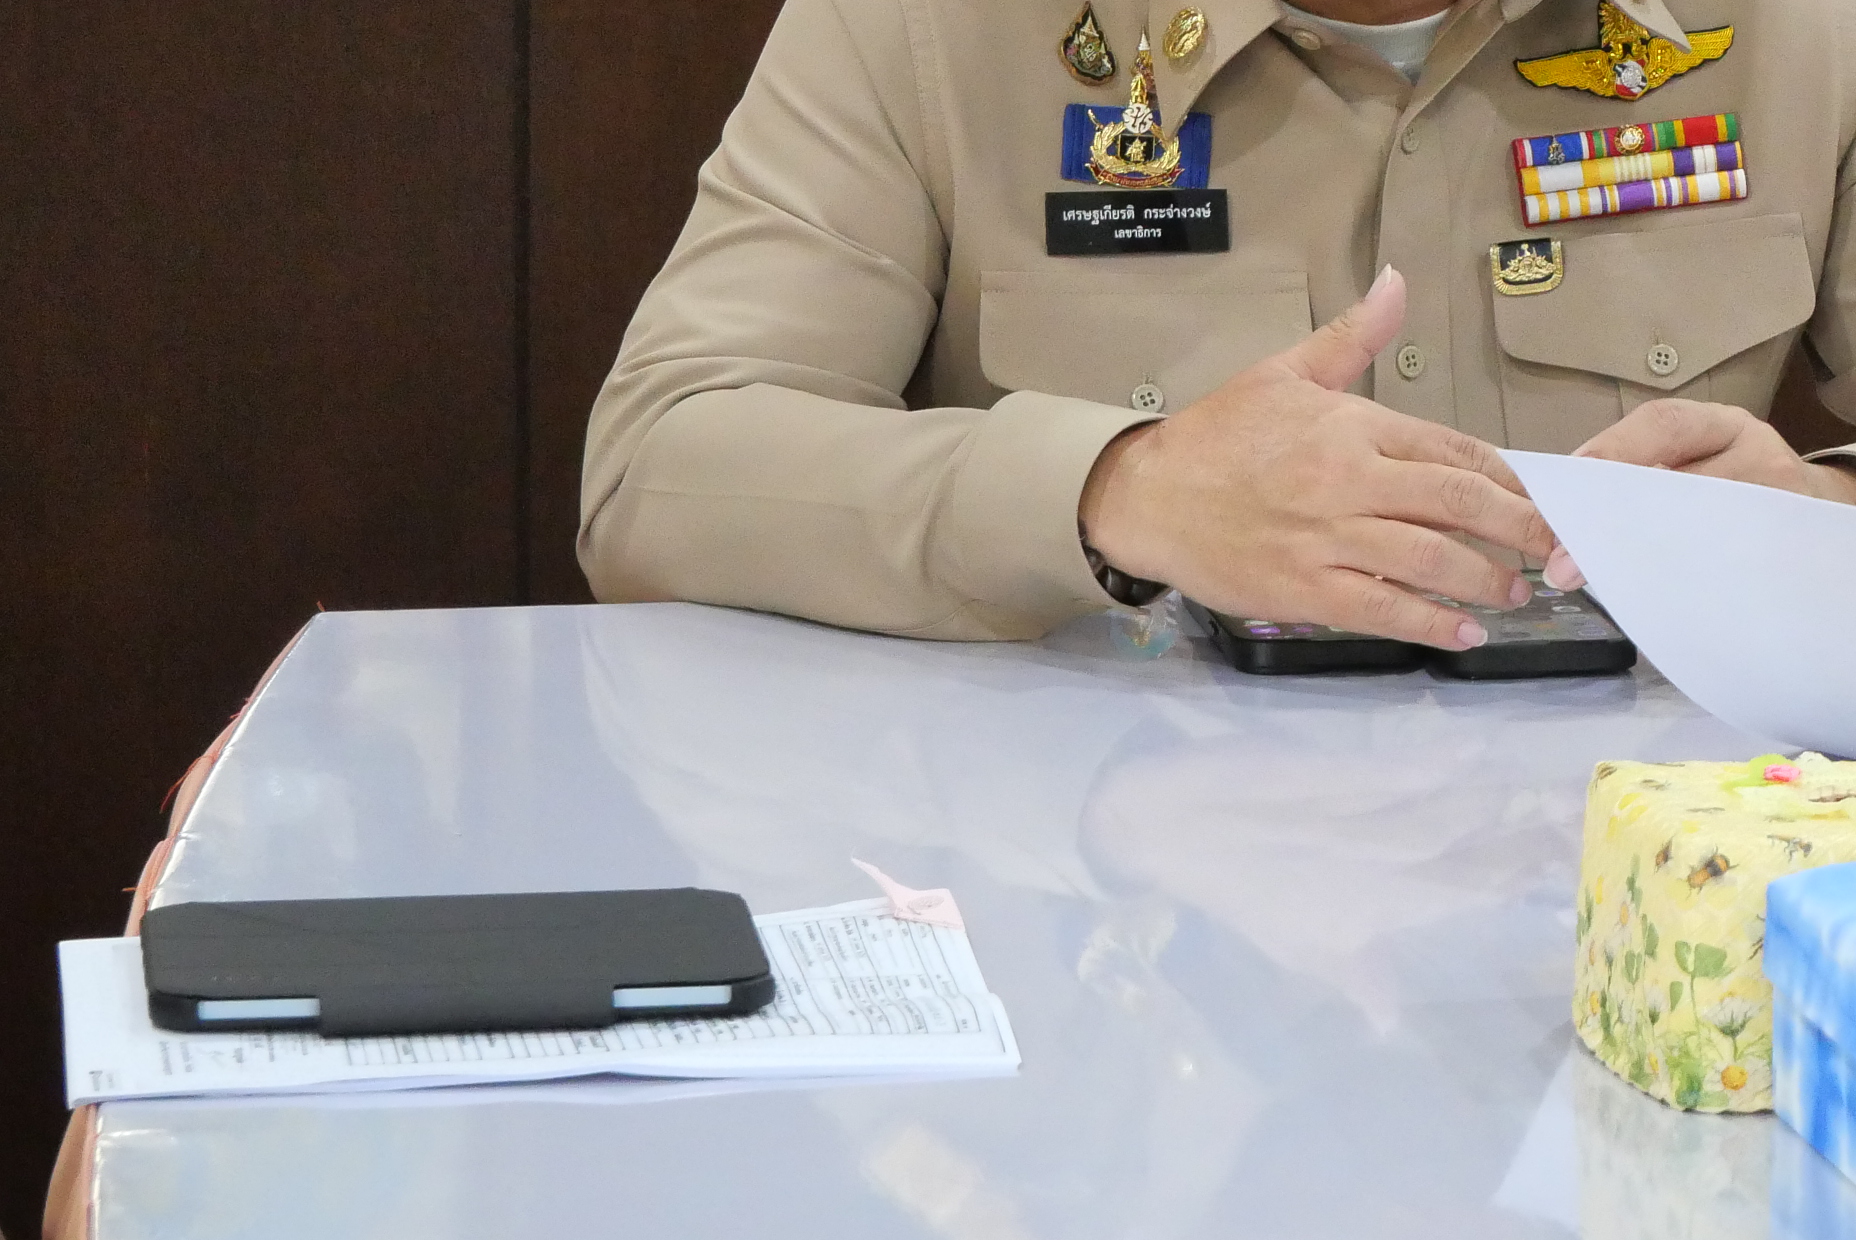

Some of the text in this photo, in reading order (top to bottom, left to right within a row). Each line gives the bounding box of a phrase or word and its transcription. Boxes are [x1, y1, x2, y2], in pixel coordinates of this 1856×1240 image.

[1062, 201, 1212, 225] เศรษฐเกียรติ กระจ่างวงษ์
[1114, 225, 1163, 239] เลขาธิการ
